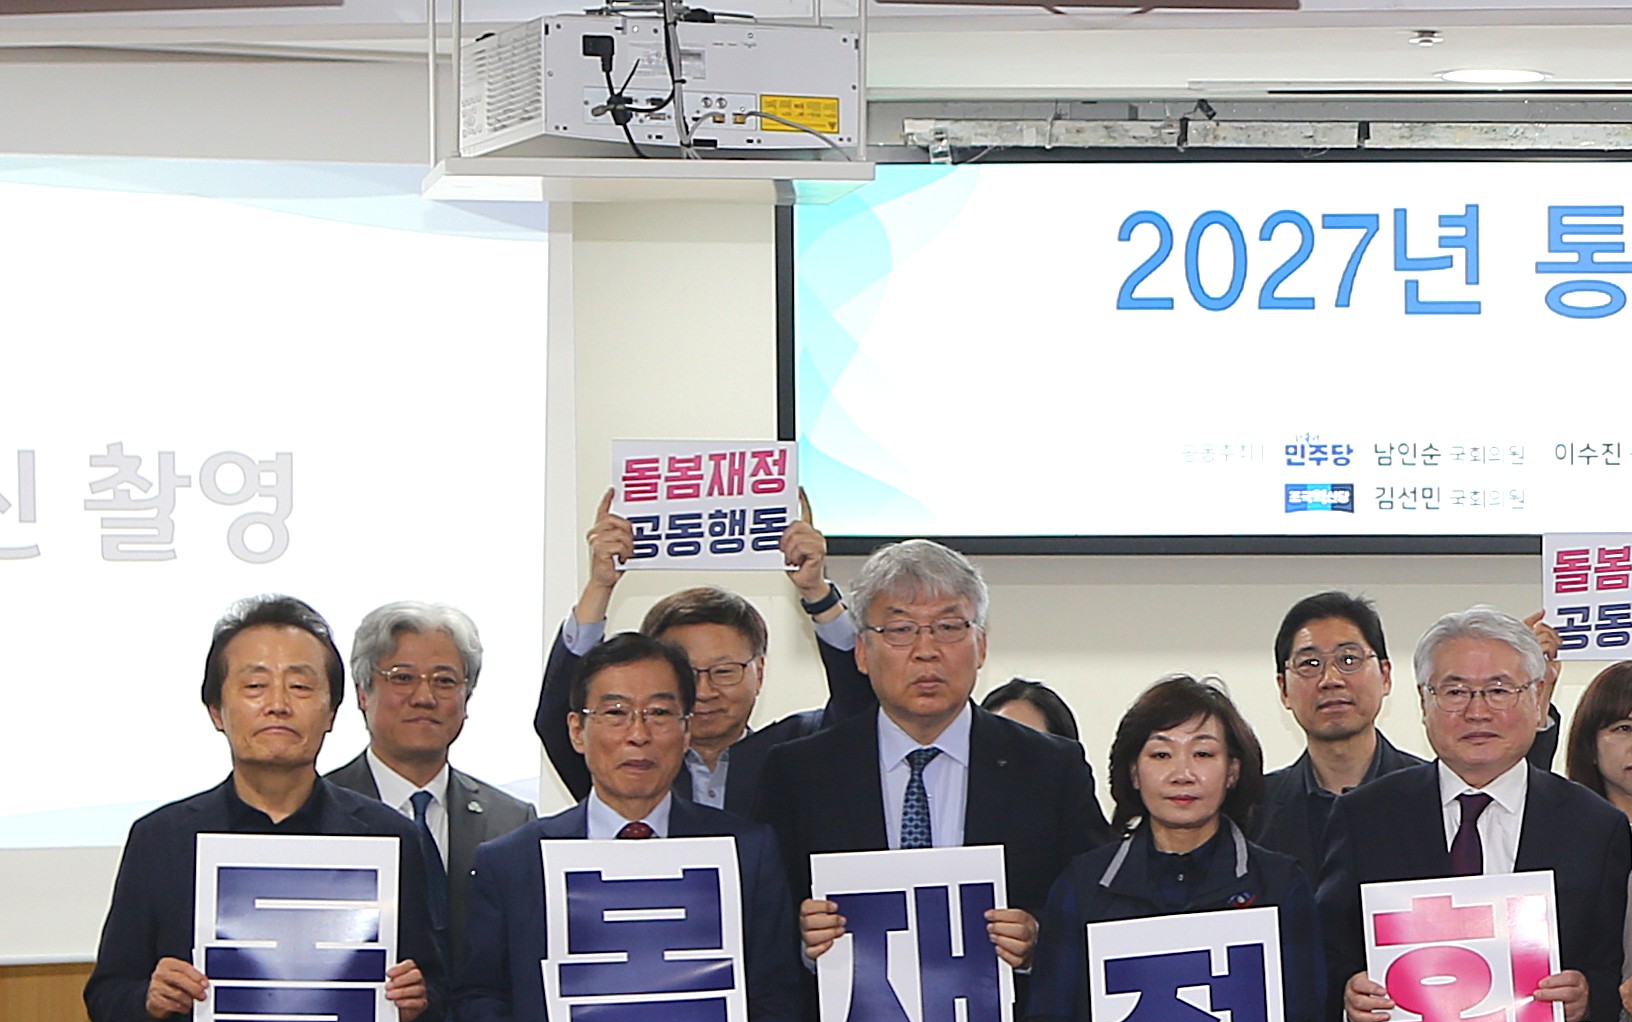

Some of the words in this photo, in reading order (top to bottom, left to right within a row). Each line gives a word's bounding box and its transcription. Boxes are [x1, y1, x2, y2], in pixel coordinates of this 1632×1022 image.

[1116, 203, 1482, 316] 2027년
[622, 448, 788, 503] 돌봄재정
[1285, 444, 1354, 467] 민주당
[1374, 442, 1442, 466] 남인순
[1555, 442, 1622, 466] 이수진
[84, 441, 293, 564] 촬영
[1375, 486, 1441, 510] 김선민
[628, 506, 789, 559] 공동행동
